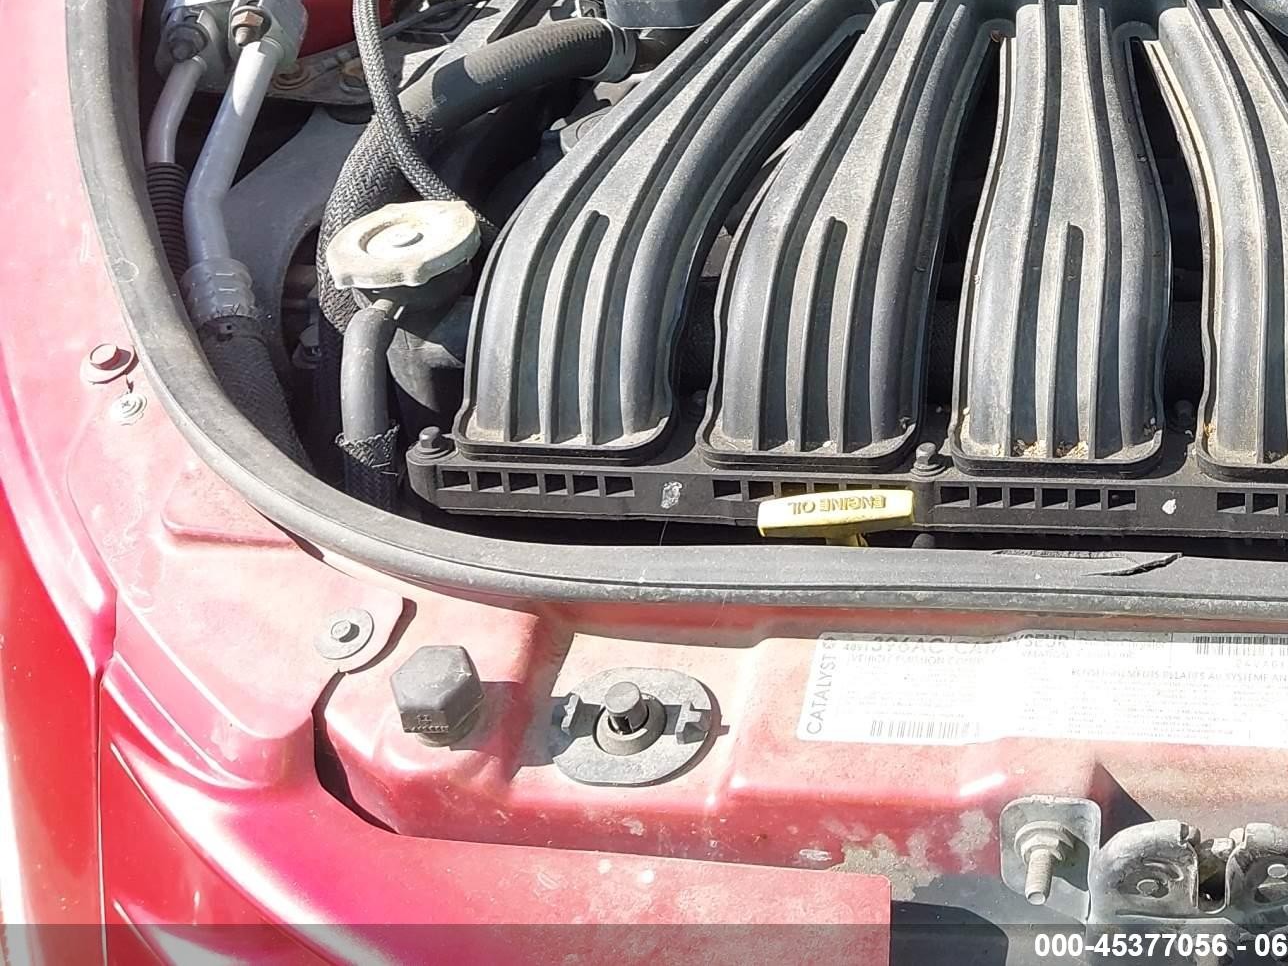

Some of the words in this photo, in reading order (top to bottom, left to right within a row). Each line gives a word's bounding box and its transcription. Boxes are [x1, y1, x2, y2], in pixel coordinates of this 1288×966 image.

[788, 500, 816, 516] OIL
[819, 495, 887, 513] ENGINE
[806, 654, 838, 735] CATALYST
